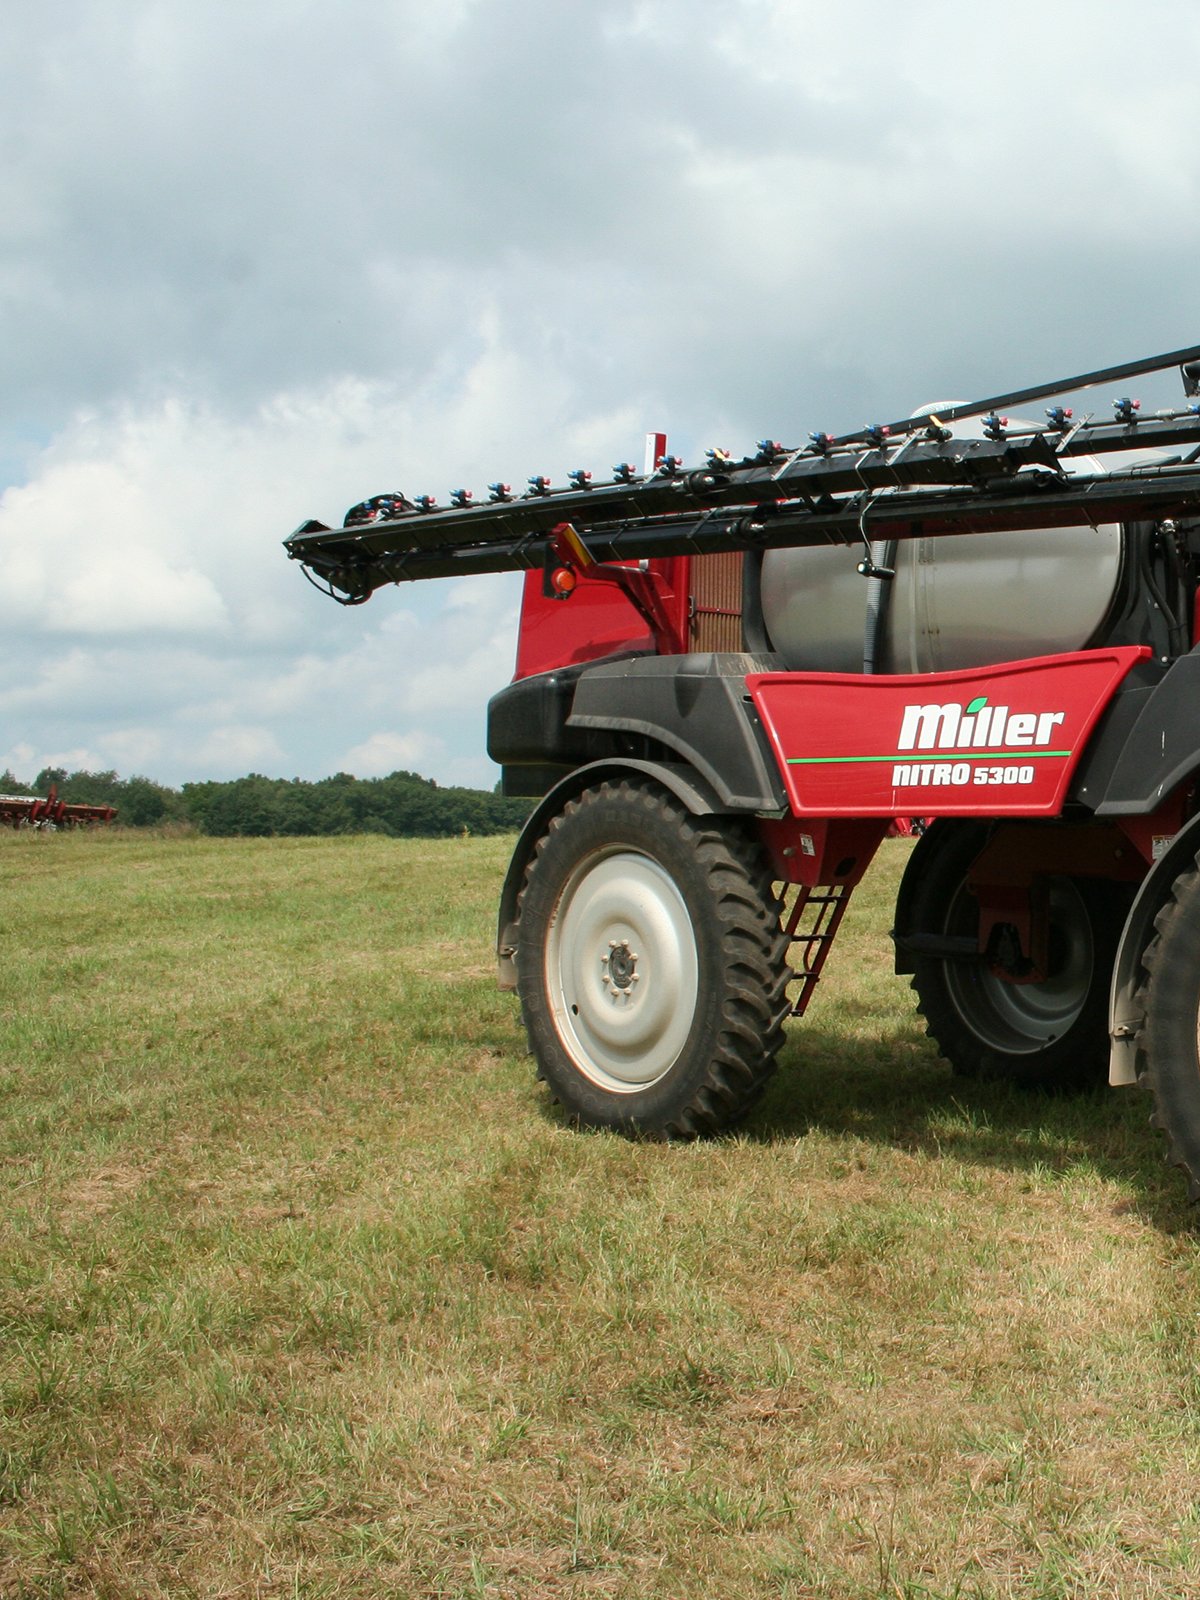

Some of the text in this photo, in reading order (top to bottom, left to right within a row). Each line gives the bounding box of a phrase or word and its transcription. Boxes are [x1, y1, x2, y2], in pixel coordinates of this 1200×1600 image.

[897, 697, 1066, 750] Miller
[891, 762, 1035, 787] NITRO 5300
